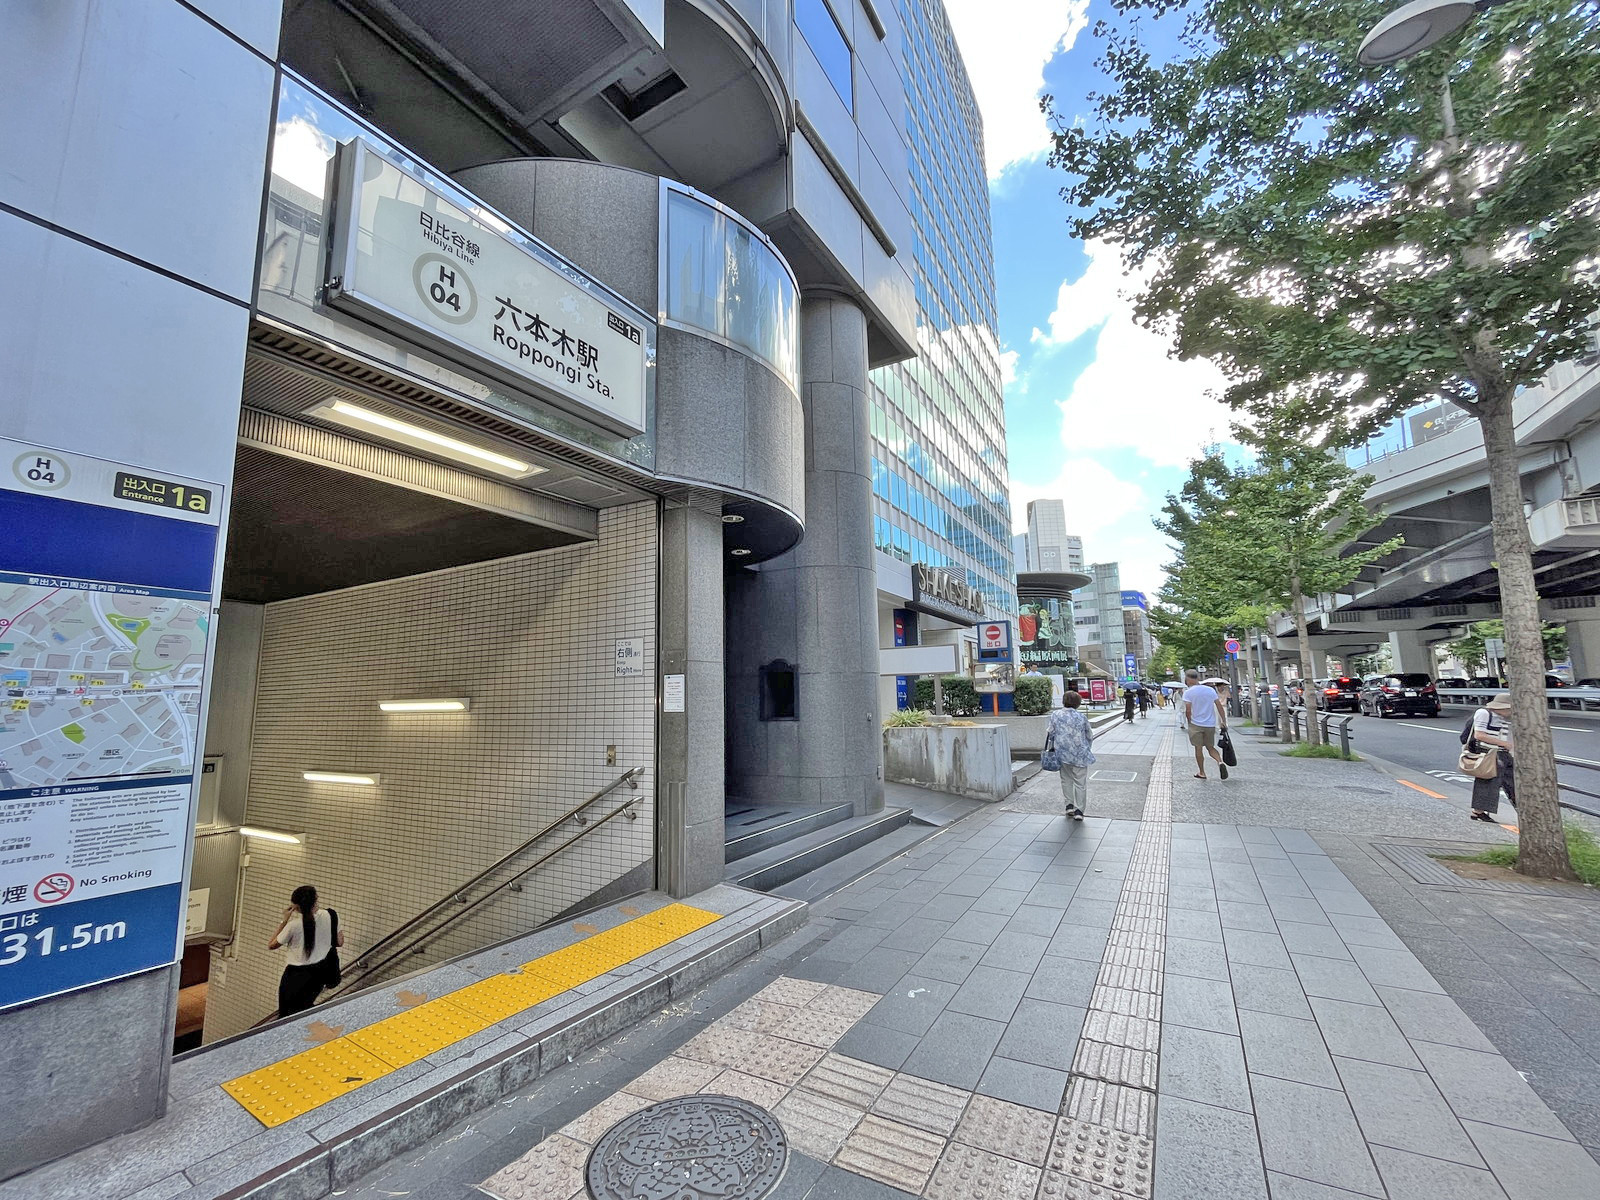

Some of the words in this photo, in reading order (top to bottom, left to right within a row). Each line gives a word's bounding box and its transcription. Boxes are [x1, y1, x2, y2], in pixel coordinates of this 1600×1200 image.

[420, 211, 480, 259] 日比谷線
[423, 230, 453, 254] Hibiya
[456, 248, 475, 266] Line
[440, 265, 455, 288] H
[430, 284, 461, 312] 04
[494, 296, 599, 374] 六本木駅
[626, 326, 638, 343] 1a
[493, 326, 581, 386] Roppongi
[587, 373, 614, 400] Sta.
[36, 458, 51, 469] H
[27, 469, 55, 483] 04
[123, 477, 165, 495] 出入口
[122, 490, 164, 504] Entrance
[171, 486, 207, 511] 1a
[918, 560, 956, 603] SHAKE
[617, 666, 632, 675] Right
[80, 878, 97, 887] No
[101, 870, 152, 883] Smoking
[0, 884, 28, 905] 煙
[0, 921, 126, 966] 31.5m
